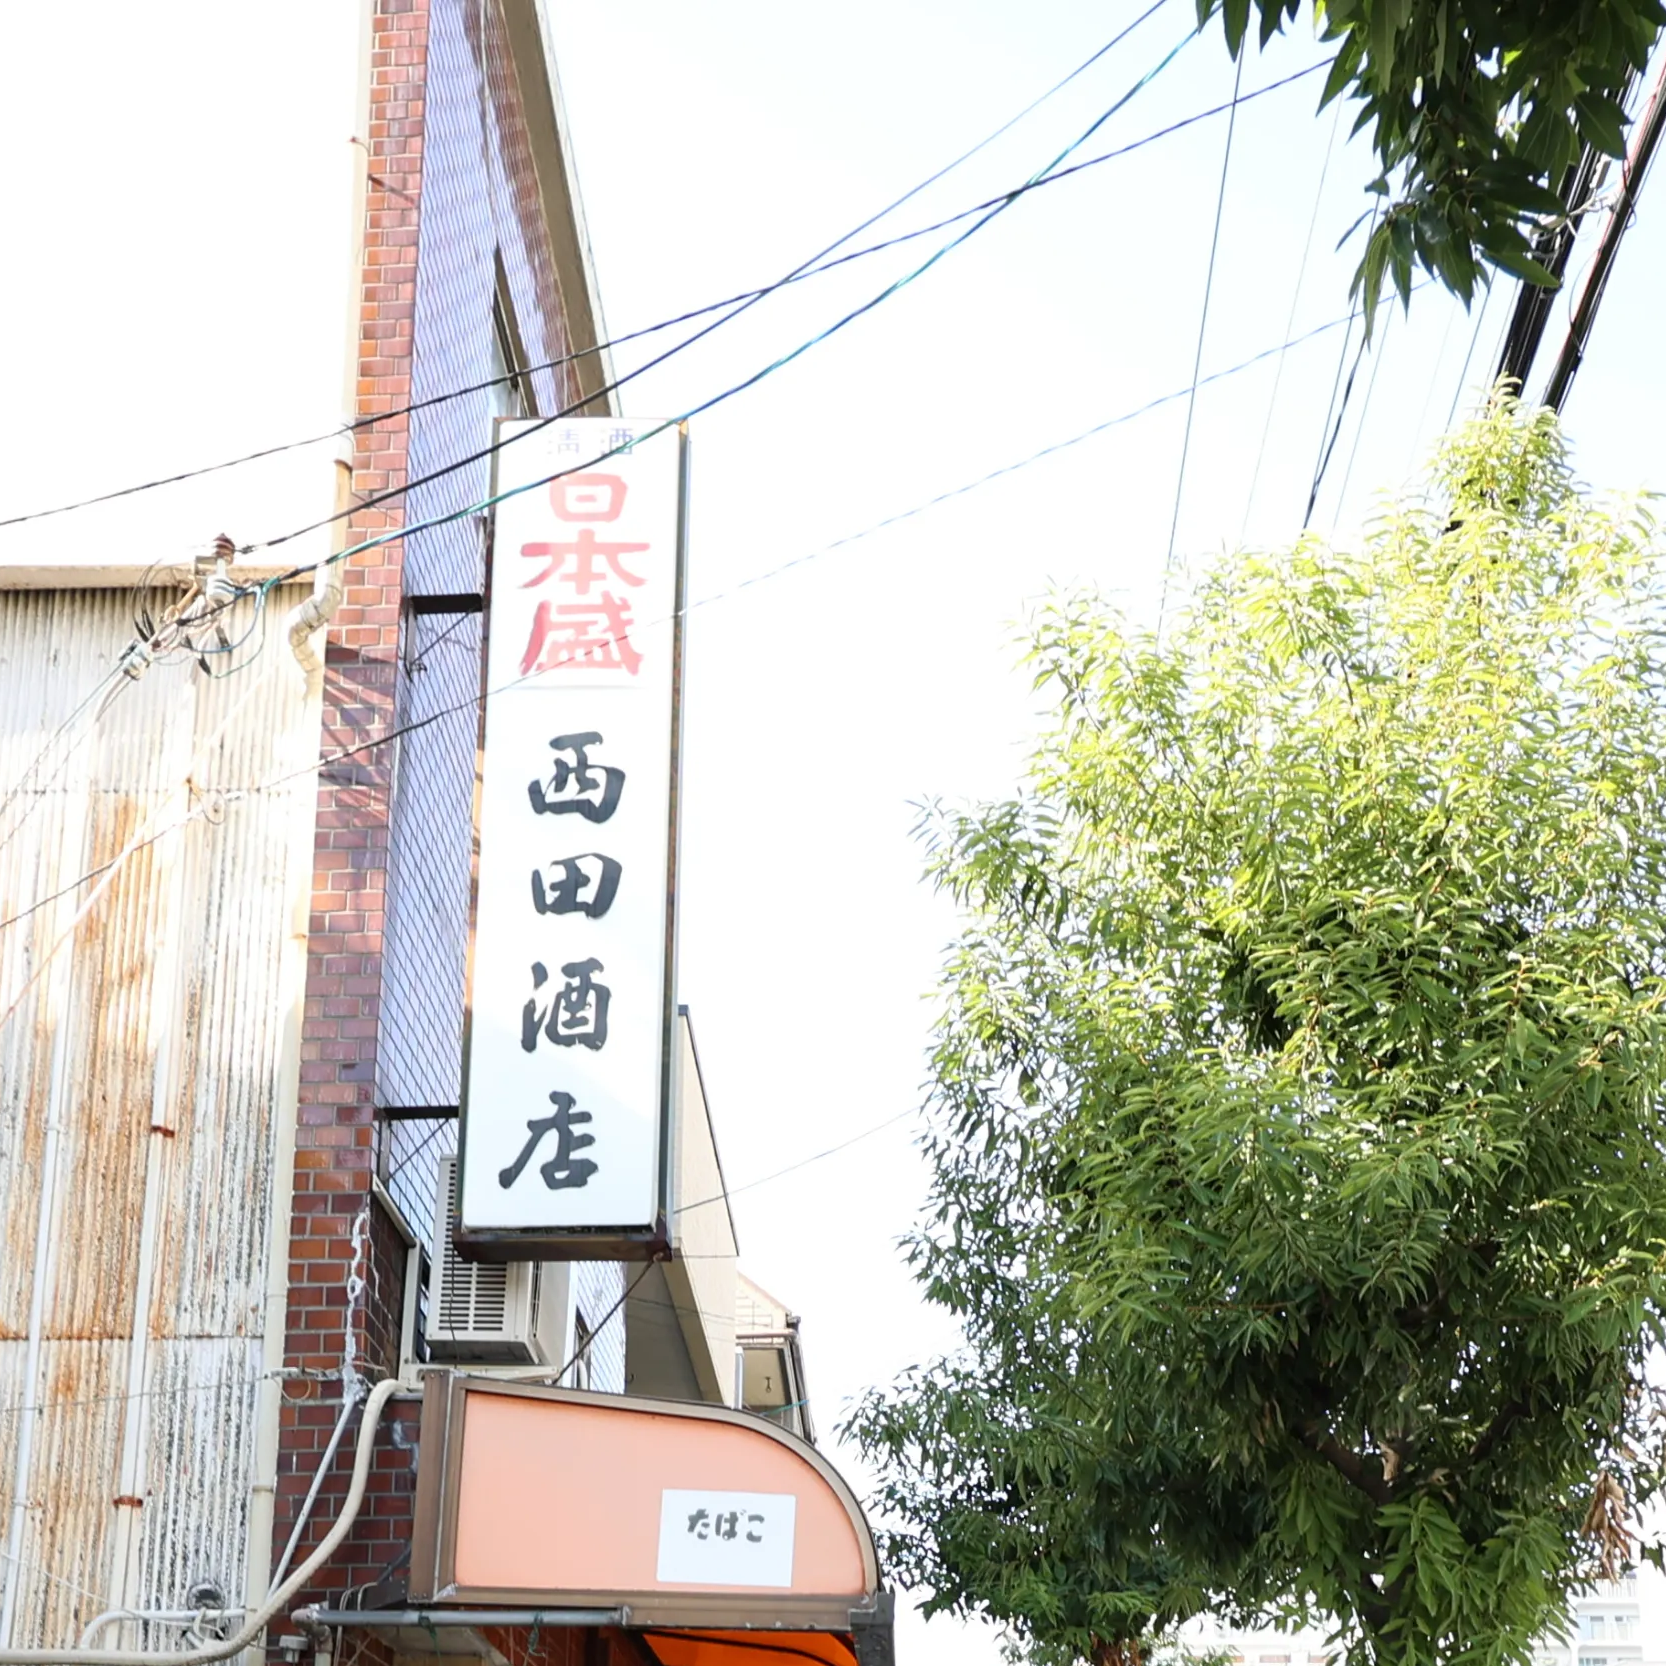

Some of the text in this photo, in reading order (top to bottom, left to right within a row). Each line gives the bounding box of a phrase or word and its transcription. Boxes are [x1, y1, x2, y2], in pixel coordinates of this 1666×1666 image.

[546, 426, 635, 457] 清酒
[517, 472, 651, 677] 日本盛
[498, 730, 627, 1191] 西田酒店
[687, 1508, 765, 1543] たばこ
